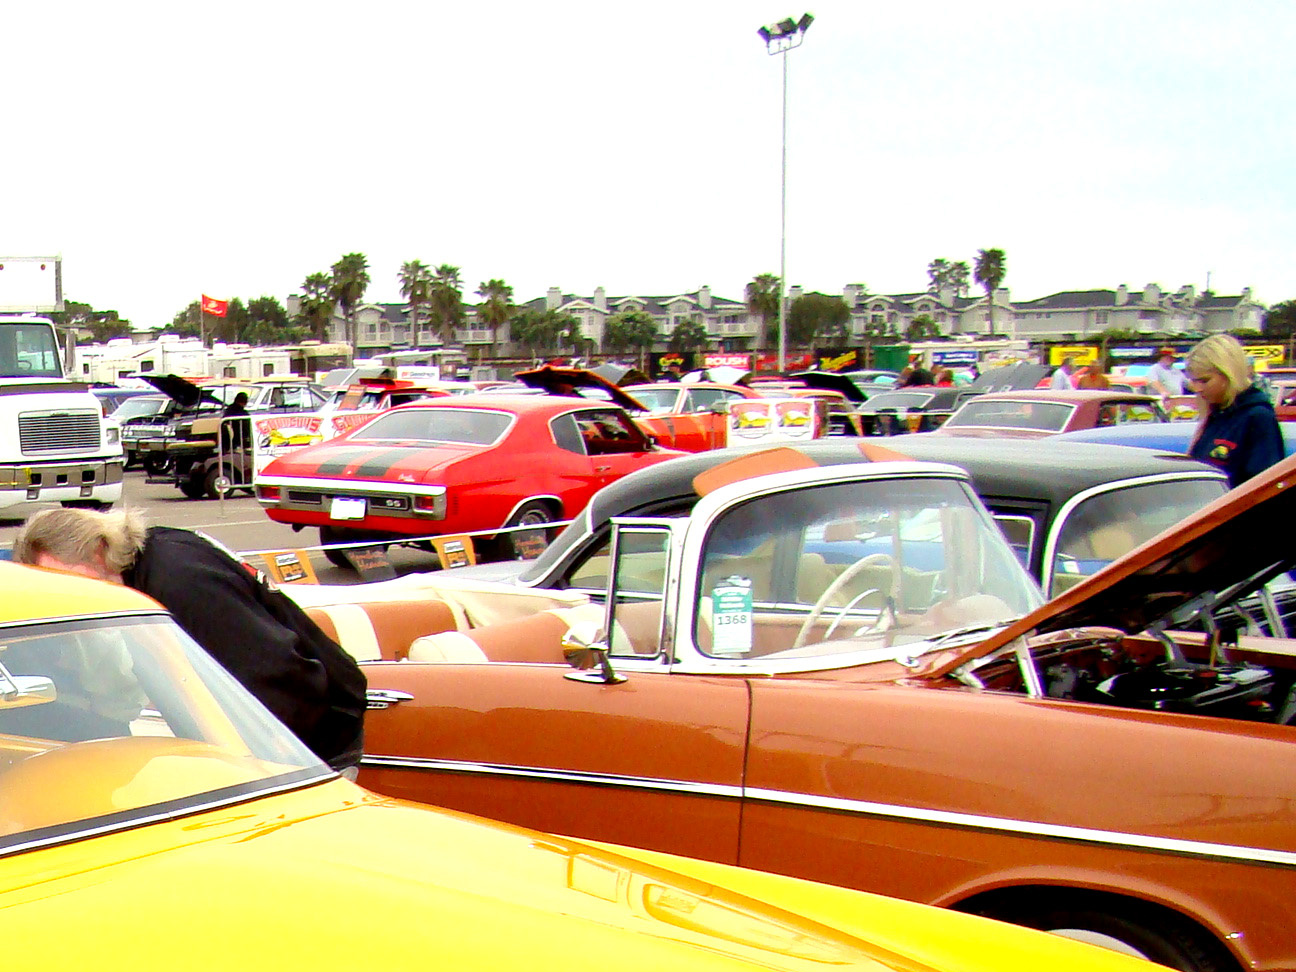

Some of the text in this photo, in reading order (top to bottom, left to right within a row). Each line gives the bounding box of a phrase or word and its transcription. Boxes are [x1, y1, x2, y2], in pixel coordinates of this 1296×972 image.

[704, 355, 749, 367] ROUSH
[385, 499, 402, 508] SS
[717, 615, 746, 625] 1368
